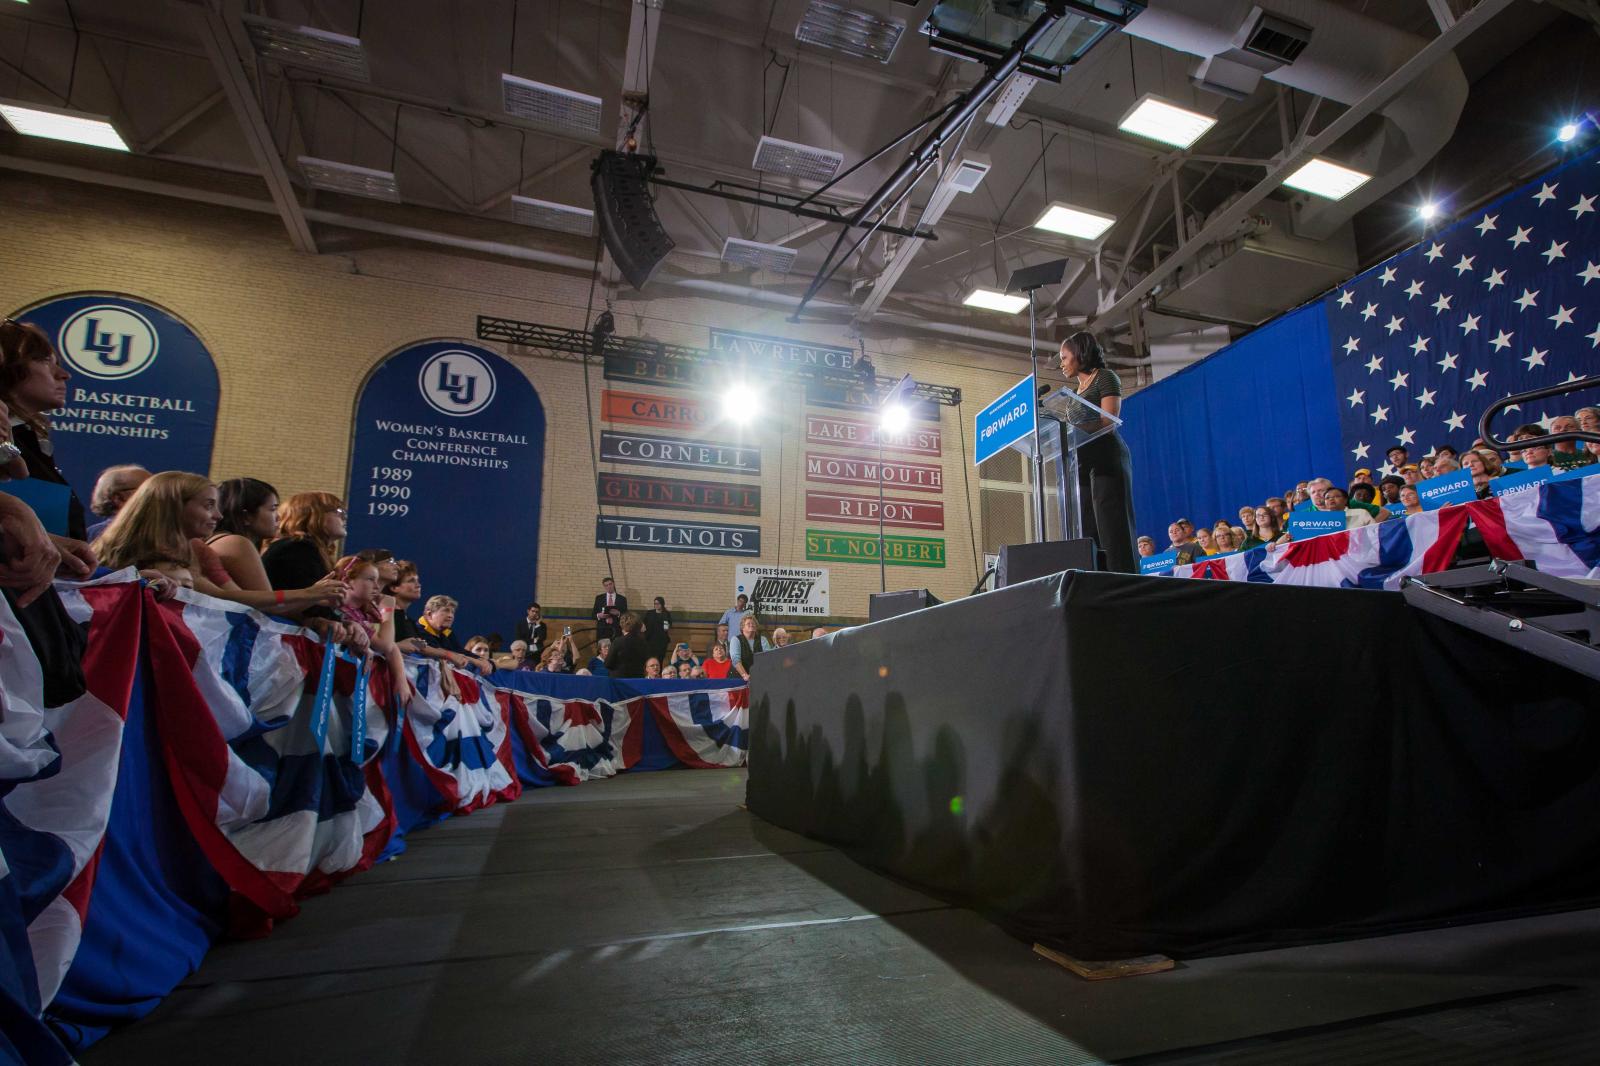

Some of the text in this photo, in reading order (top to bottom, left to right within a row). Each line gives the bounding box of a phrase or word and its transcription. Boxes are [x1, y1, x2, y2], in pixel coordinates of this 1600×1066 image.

[82, 318, 135, 367] LU
[713, 335, 853, 368] LAWRENCE
[437, 361, 477, 404] LU
[74, 388, 196, 412] BASKETBALL
[49, 420, 169, 440] AMPIONSHIPS
[375, 420, 528, 445] WOMEN'S BASKETBALL
[807, 421, 857, 440] LAKE
[406, 438, 498, 456] CONFERENCE
[618, 440, 747, 468] CORNELL
[392, 449, 509, 469] CHAMPIONSHIPS
[371, 466, 412, 482] 1989
[807, 459, 942, 486] MONMOUTH
[369, 484, 411, 500] 1990
[605, 481, 755, 508] GRINNELL
[367, 502, 409, 518] 1999
[839, 500, 913, 520] RIPON
[615, 524, 744, 548] ILLINOIS
[808, 537, 944, 560] ST. NORBERT
[743, 567, 822, 578] SPORTSMANSHIP
[751, 579, 815, 600] MIDWEST
[744, 603, 784, 613] APENS
[802, 606, 825, 614] HERE
